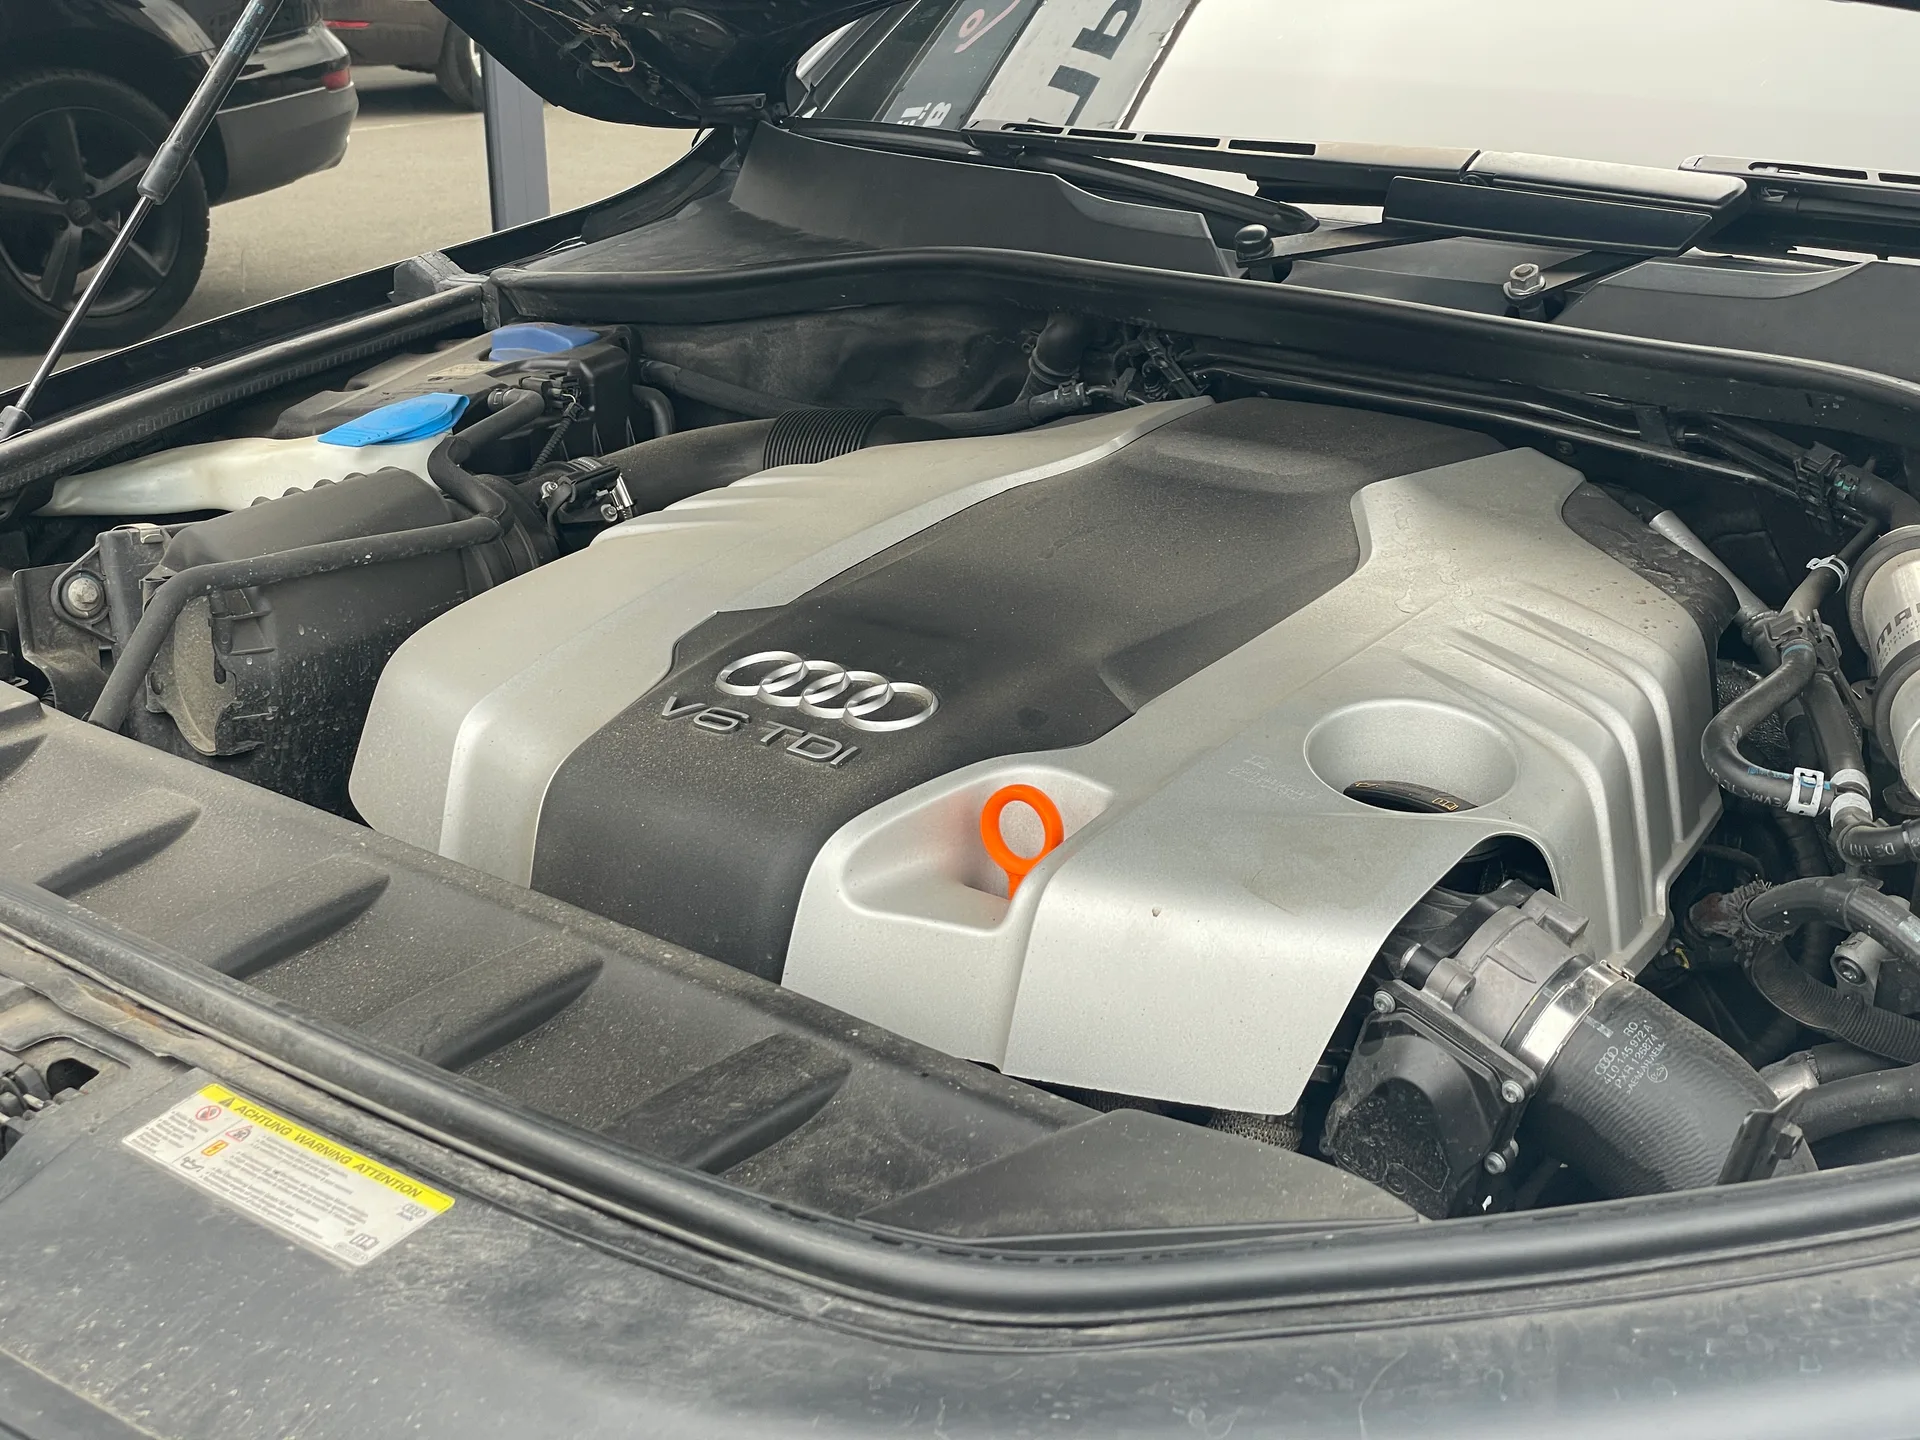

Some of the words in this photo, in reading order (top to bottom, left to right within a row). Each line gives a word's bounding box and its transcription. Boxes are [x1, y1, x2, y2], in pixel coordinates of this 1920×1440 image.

[660, 694, 750, 734] V6
[760, 720, 860, 769] TDI
[1617, 1046, 1633, 1063] 145
[1629, 1030, 1647, 1048] 972
[234, 1104, 293, 1136] ACHTUNG
[293, 1133, 354, 1165] WARNING
[355, 1162, 423, 1198] ATTENTION
